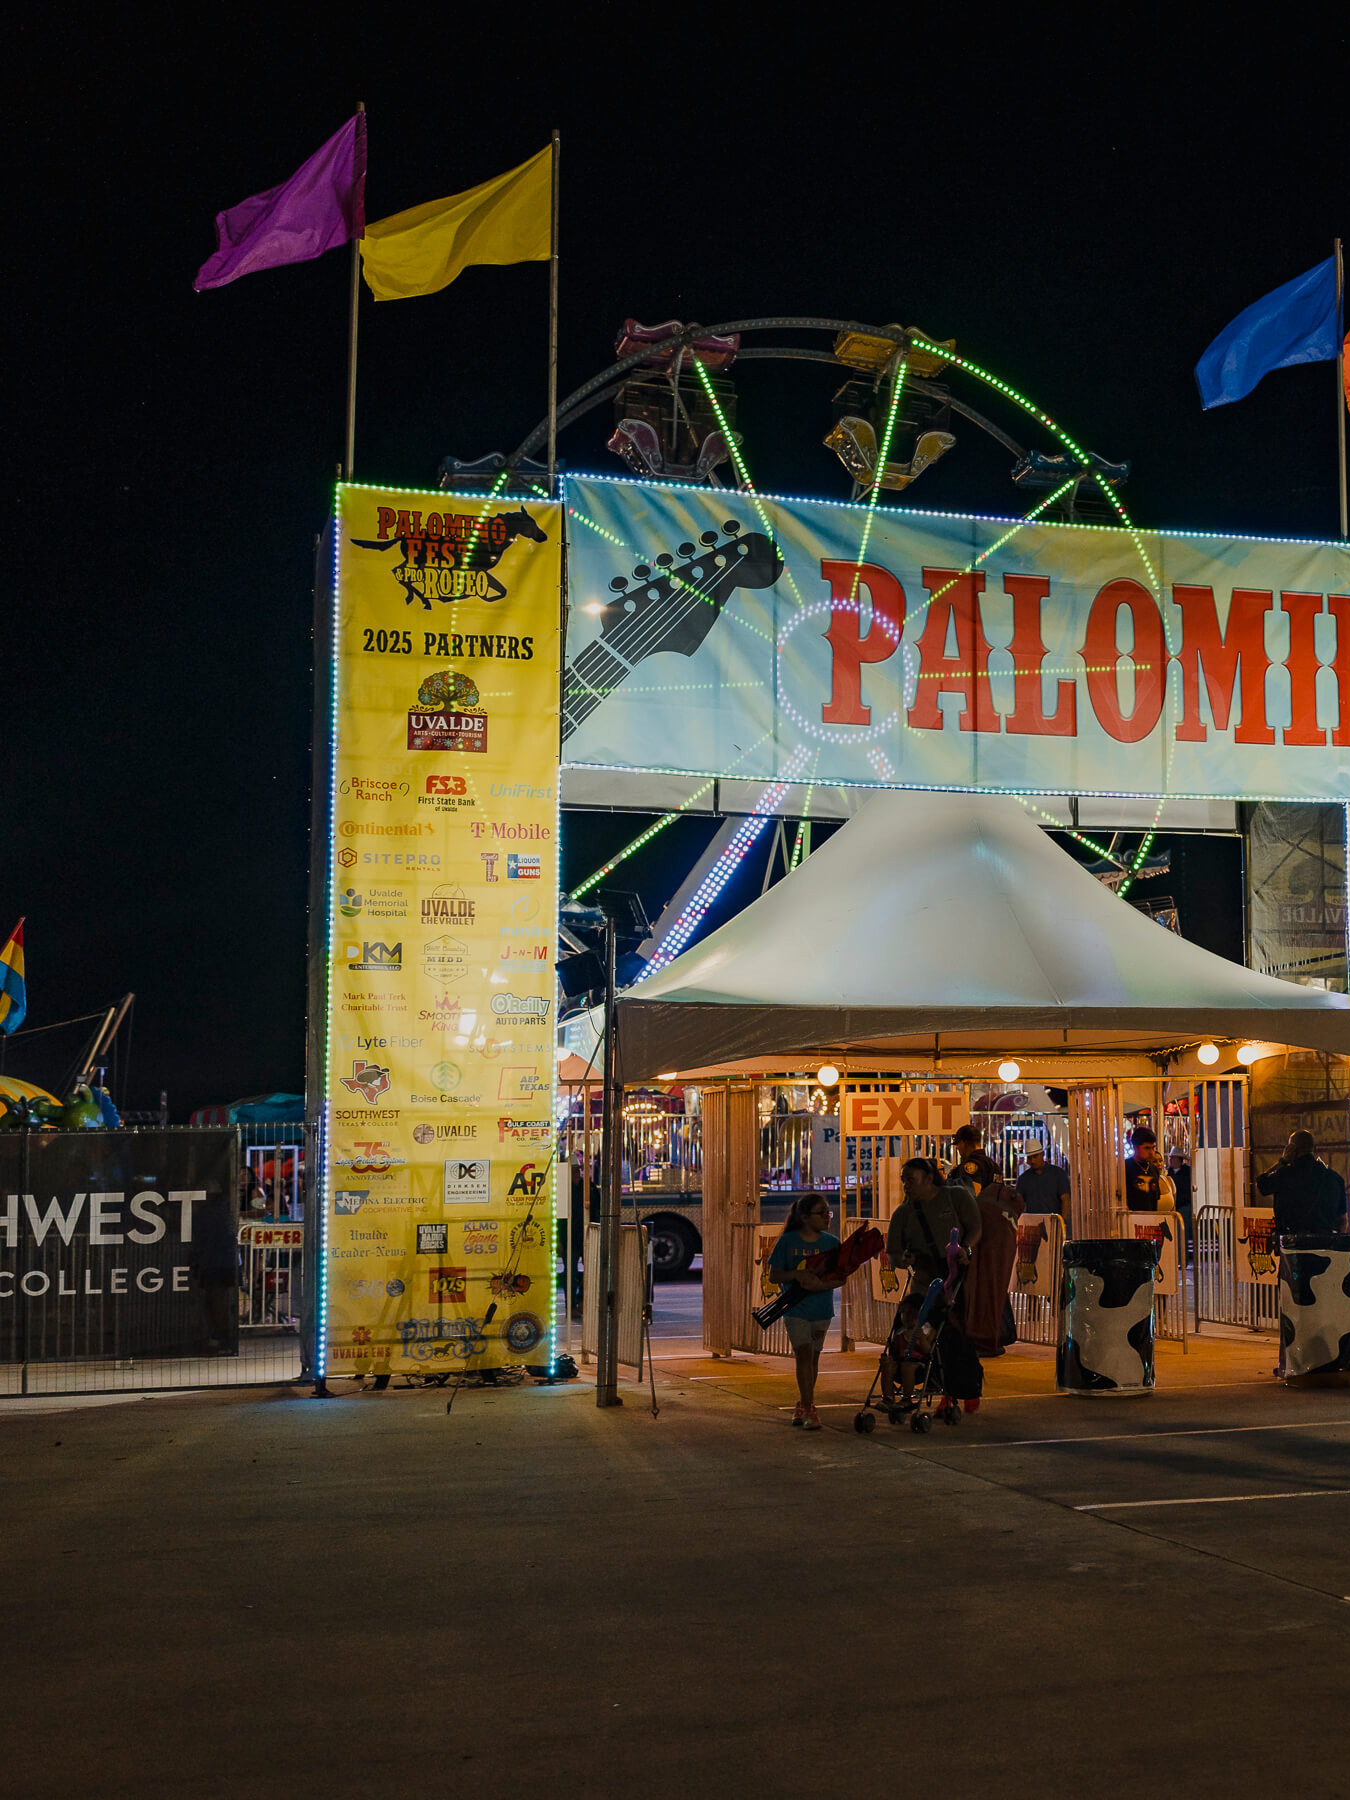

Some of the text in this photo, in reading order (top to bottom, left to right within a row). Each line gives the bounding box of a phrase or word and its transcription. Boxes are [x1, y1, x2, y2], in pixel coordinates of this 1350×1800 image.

[377, 507, 507, 545] PALOMINO
[406, 539, 473, 569] FEST
[424, 567, 488, 599] RODEO
[363, 629, 533, 660] 2025 PARTNERS
[411, 715, 484, 731] UVALDE
[352, 777, 397, 790] Briscoe
[356, 789, 392, 802] Ranch
[490, 783, 552, 799] UniFirst
[418, 797, 476, 807] First State Bank
[339, 820, 422, 838] Continental
[363, 853, 441, 865] SITEPRO
[518, 869, 541, 877] GUNS
[369, 889, 403, 898] Uvalde
[364, 899, 408, 908] Memorial
[421, 900, 476, 918] UVALDE
[368, 908, 407, 918] Hospital
[421, 918, 476, 926] CHEVROLET
[500, 926, 551, 937] minits
[343, 993, 365, 1001] Mark
[493, 994, 548, 1015] O'Reilly
[357, 1036, 423, 1050] Lyte Fiber
[520, 1075, 539, 1083] AEP
[520, 1083, 550, 1091] TEXAS
[411, 1095, 481, 1103] Boise Cascade
[335, 1109, 400, 1120] SOUTHWEST
[852, 1097, 962, 1132] EXIT
[437, 1125, 477, 1138] UVALDE
[499, 1118, 550, 1143] PAPER
[344, 1197, 428, 1206] MEDINA ELECTRIC
[419, 1225, 446, 1234] UVALDE
[464, 1222, 498, 1231] KLMO
[349, 1230, 388, 1241] Uvalde
[331, 1246, 406, 1258] Leader-News
[464, 1243, 498, 1254] 98.9
[432, 1277, 466, 1293] 107.9
[333, 1346, 391, 1360] UVALDE EMS
